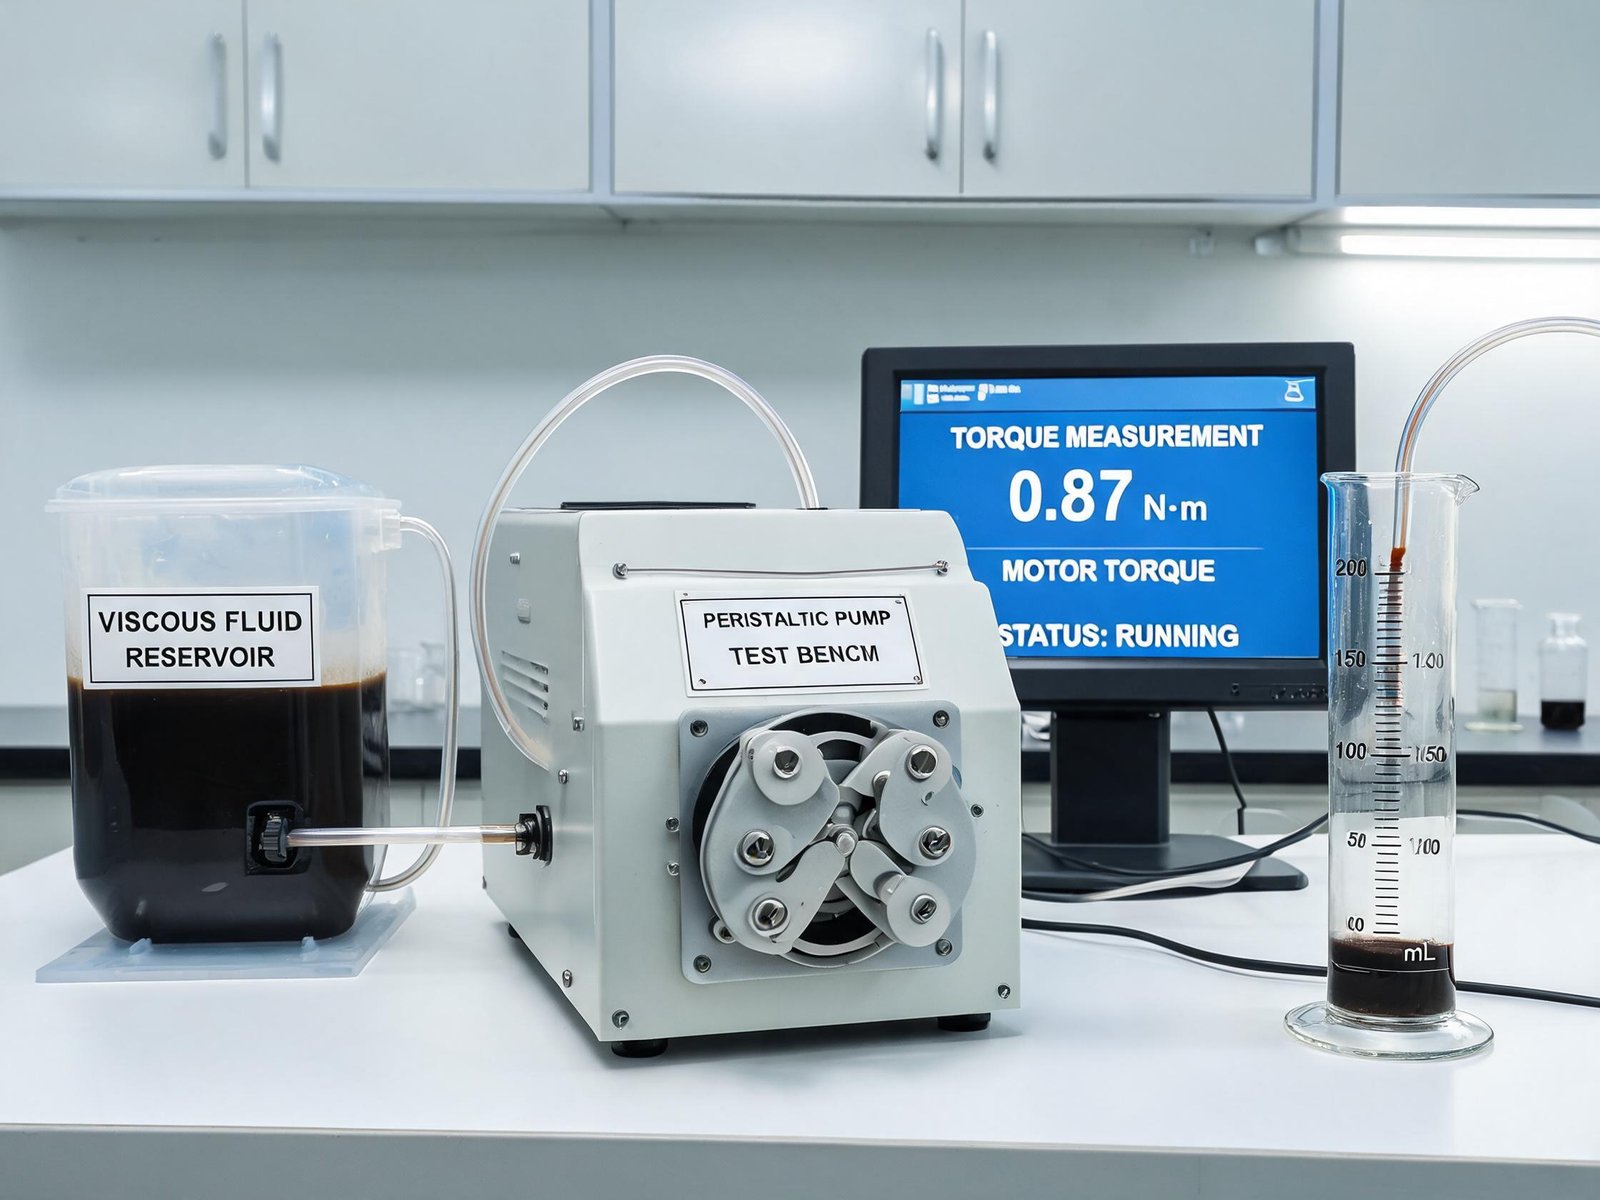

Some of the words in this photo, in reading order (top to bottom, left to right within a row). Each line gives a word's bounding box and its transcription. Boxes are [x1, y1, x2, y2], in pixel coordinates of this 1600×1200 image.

[951, 425, 1059, 451] TORQUE
[1066, 424, 1263, 448] MEASUREMENT
[1009, 469, 1133, 522] 0.87
[1002, 559, 1097, 582] MOTOR
[1104, 559, 1215, 584] TORQUE
[1336, 559, 1367, 577] 200
[98, 610, 216, 633] VISCOUS
[225, 610, 302, 632] FLUID
[703, 611, 829, 628] PERISTALTIC
[835, 610, 891, 626] PUMP
[998, 623, 1107, 648] STATUS:
[1116, 623, 1239, 648] RUNNING
[126, 646, 275, 668] RESERVOIR
[729, 646, 789, 665] TEST
[797, 645, 880, 664] BENCM
[1335, 650, 1366, 667] 150
[1336, 742, 1367, 760] 100
[1347, 832, 1367, 848] 50
[1404, 942, 1436, 962] mL
